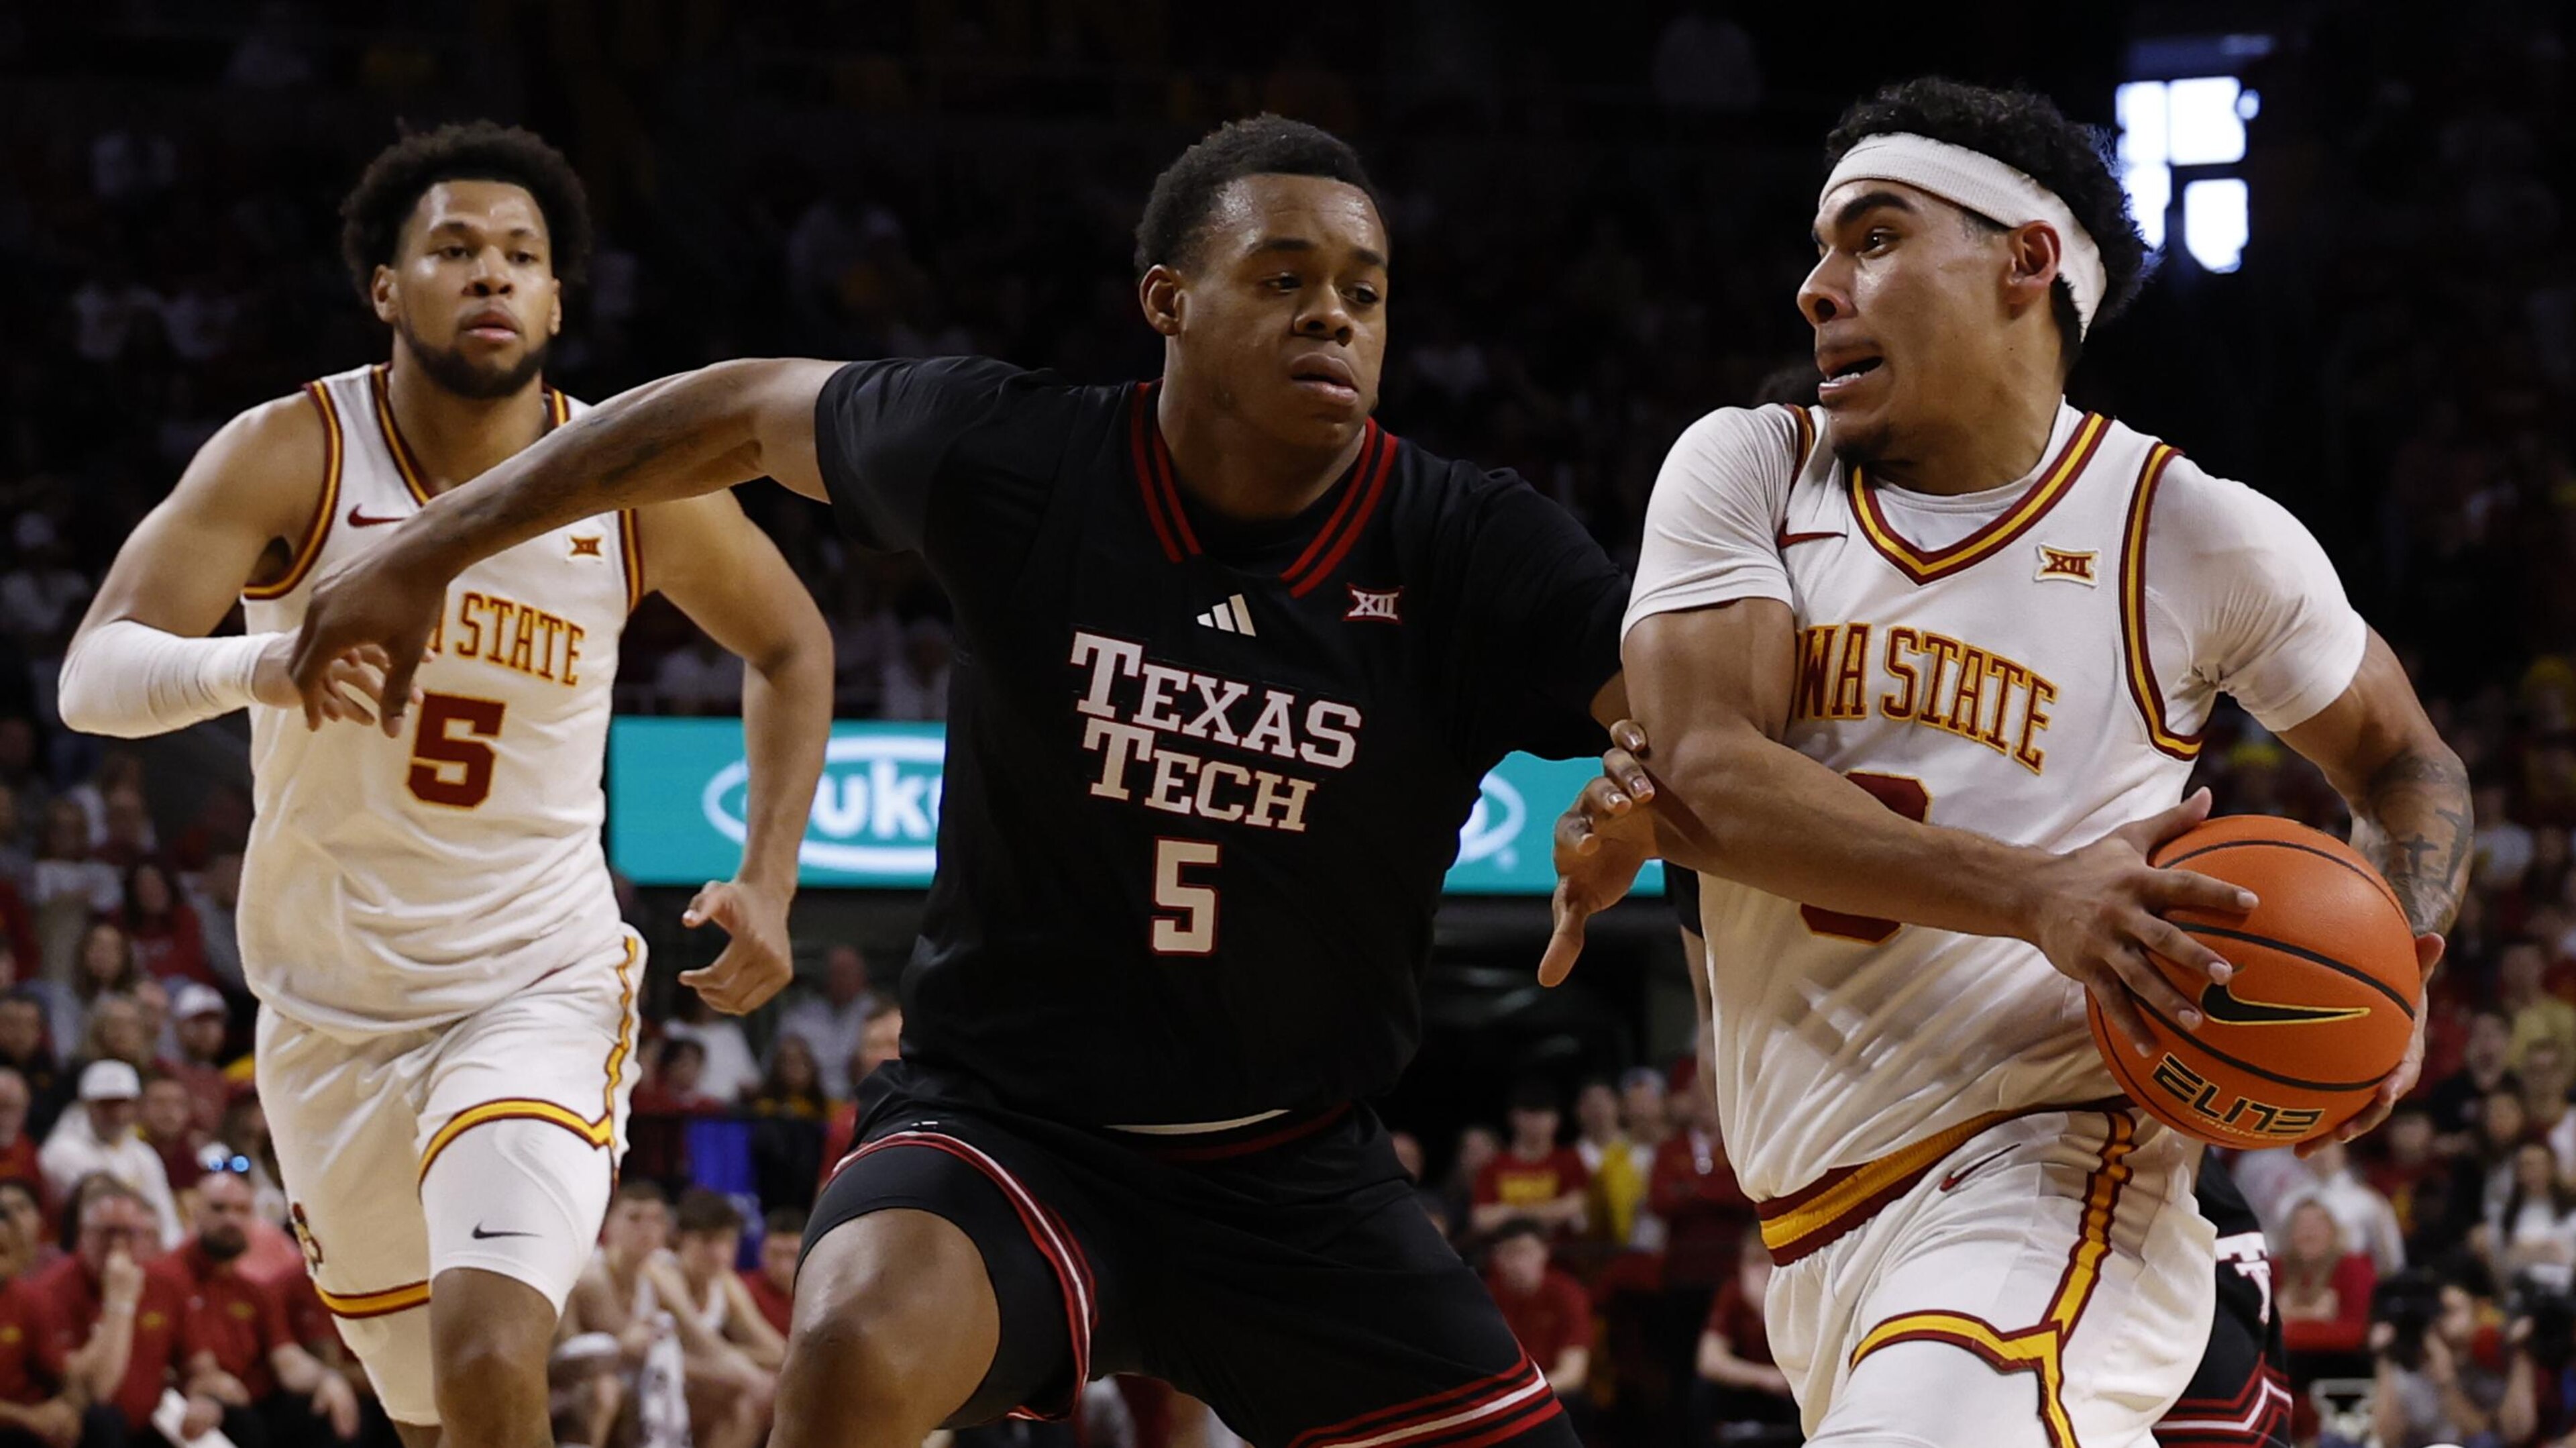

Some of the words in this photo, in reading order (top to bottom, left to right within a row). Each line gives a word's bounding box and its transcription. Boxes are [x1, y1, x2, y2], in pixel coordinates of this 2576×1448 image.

[1345, 586, 1403, 622] XII
[2042, 550, 2092, 579] XII
[454, 590, 585, 688] STATE
[407, 690, 506, 809] 5
[1069, 630, 1362, 769] TEXAS
[1795, 623, 1872, 720] WA
[1880, 625, 2058, 776] STATE
[1081, 716, 1317, 832] TECH
[1150, 837, 1221, 955] 5
[2152, 1051, 2326, 1135] ELITE
